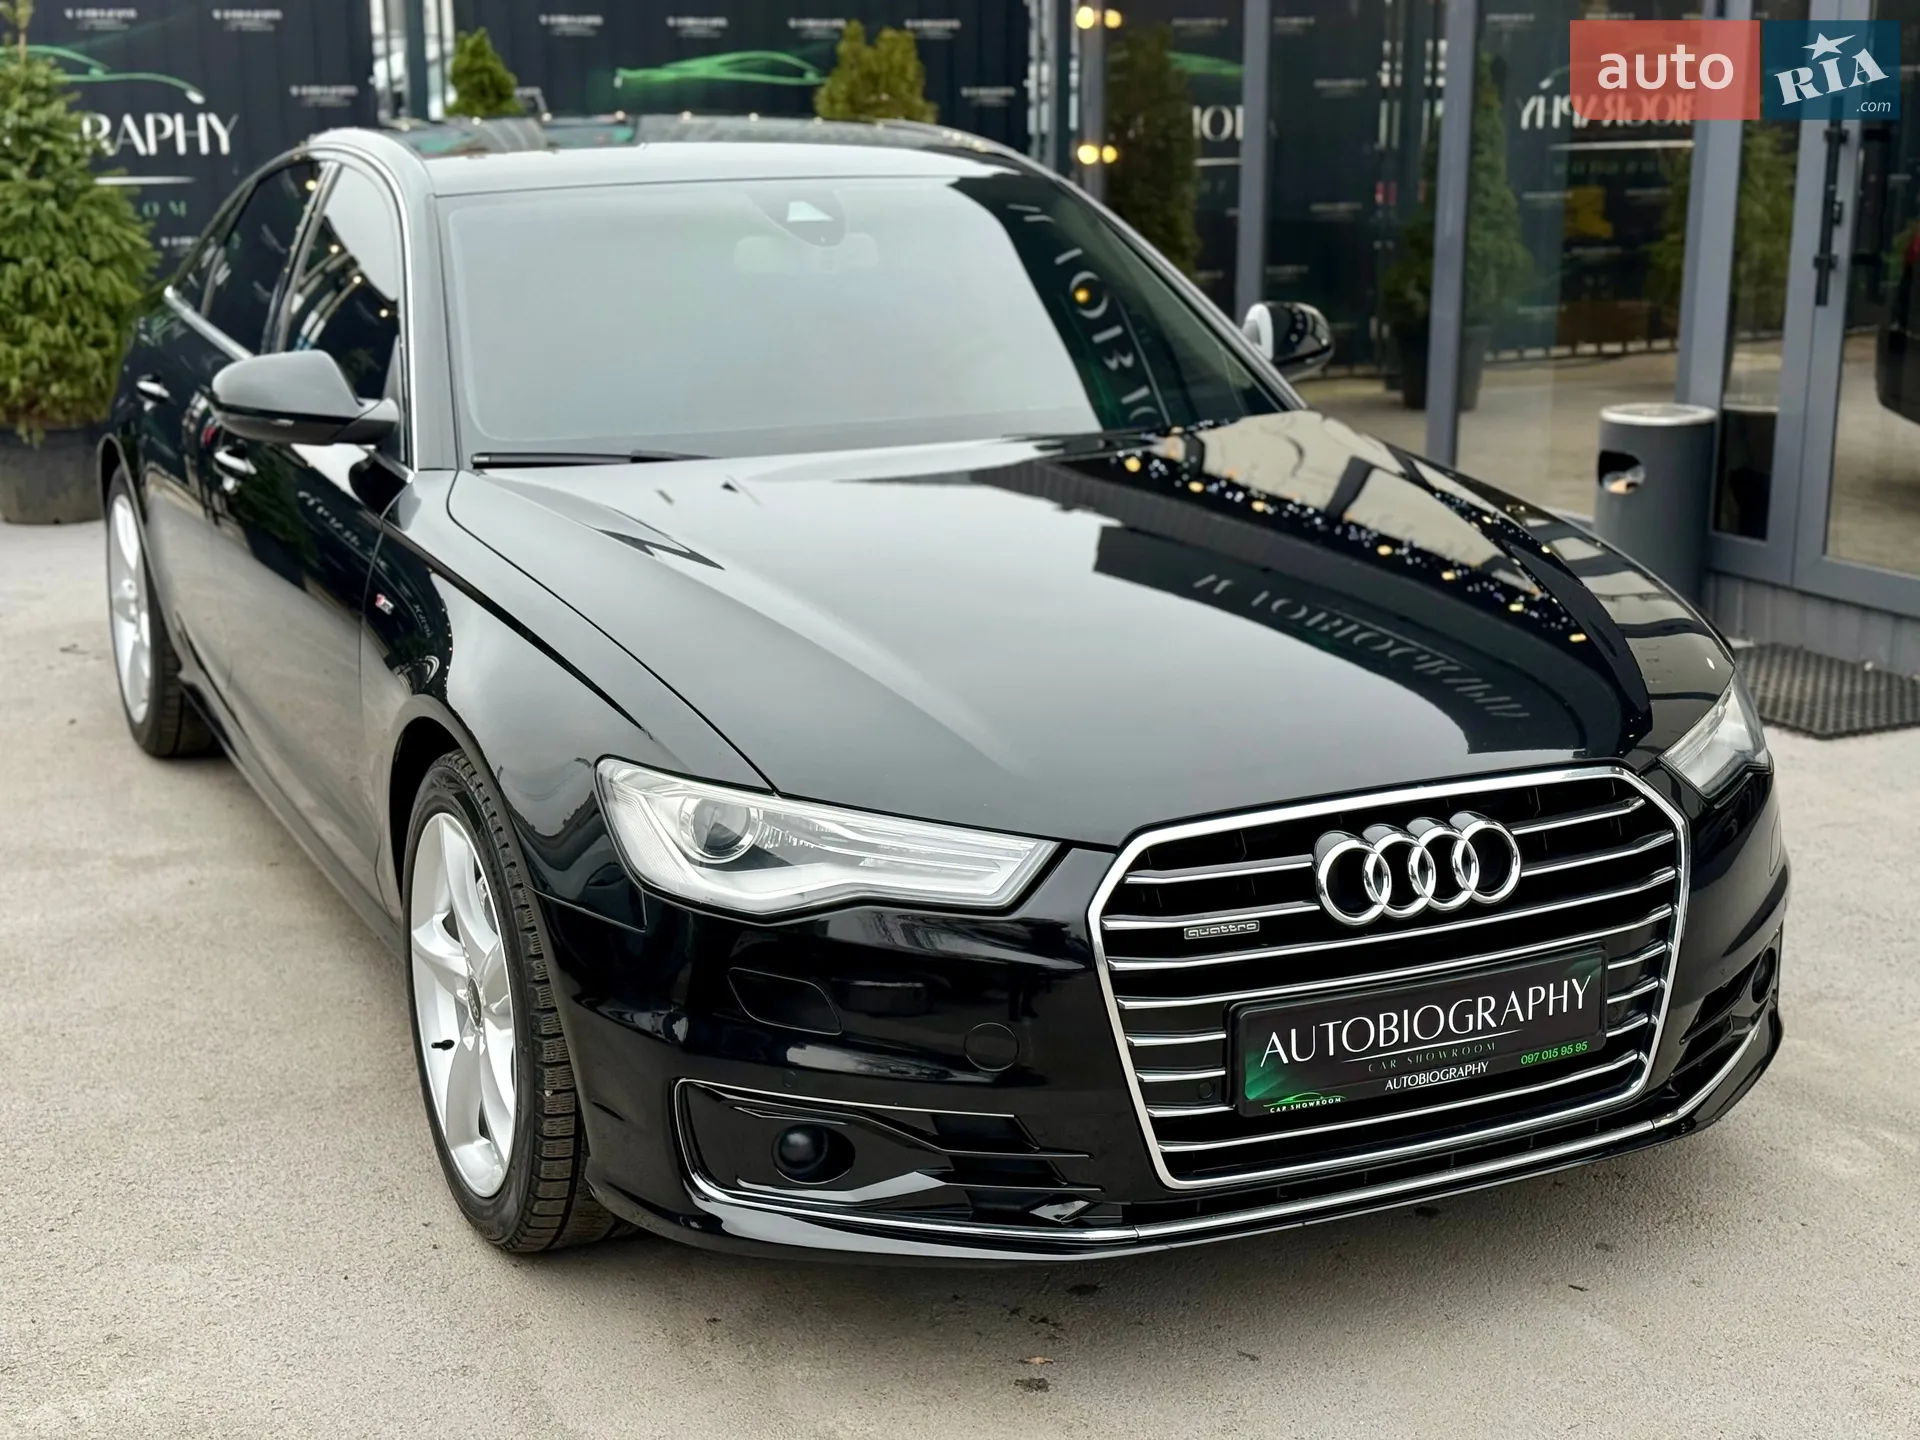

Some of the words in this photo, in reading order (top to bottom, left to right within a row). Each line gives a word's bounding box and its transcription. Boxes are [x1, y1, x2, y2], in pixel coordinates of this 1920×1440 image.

[1187, 922, 1257, 937] quattro
[1260, 974, 1592, 1068] AUTOBIOGRAPHY
[1368, 1058, 1397, 1073] CAR
[1406, 1042, 1496, 1065] SHOWROOM
[1520, 1053, 1539, 1065] 097
[1541, 1048, 1559, 1061] 015
[1560, 1044, 1574, 1056] 95
[1575, 1041, 1588, 1052] 95
[1384, 1061, 1490, 1091] AUTOBIOGRAPHY
[1269, 1104, 1288, 1114] CAR
[1290, 1096, 1342, 1110] SHOWROOM
